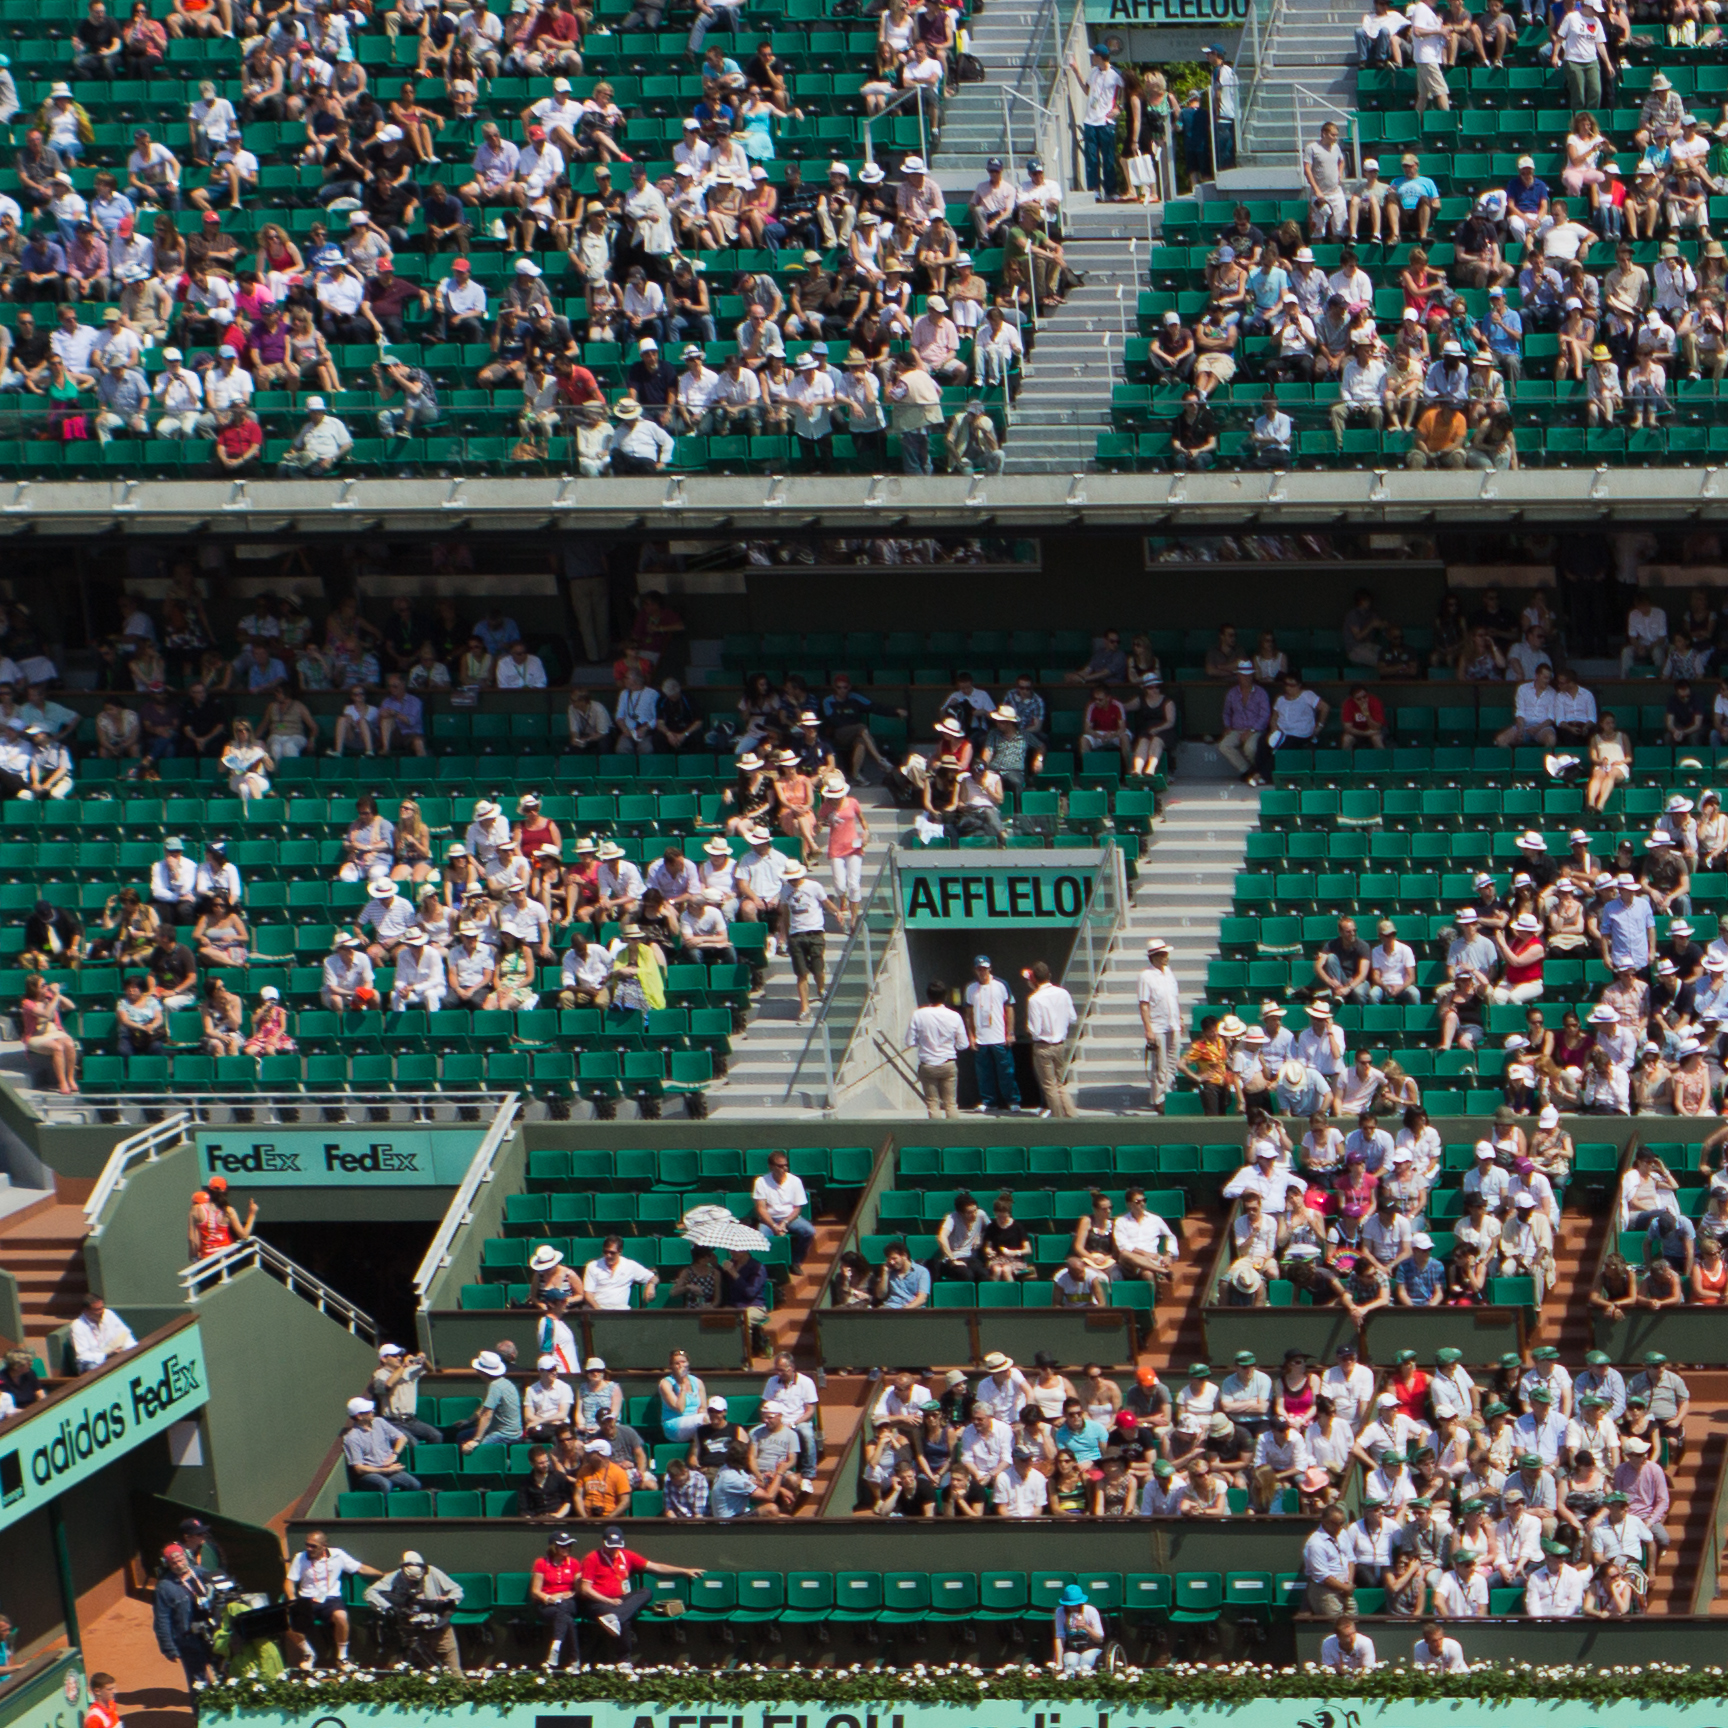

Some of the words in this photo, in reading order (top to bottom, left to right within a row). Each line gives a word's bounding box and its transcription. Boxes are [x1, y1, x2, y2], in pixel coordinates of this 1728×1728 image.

[206, 1144, 302, 1173] FedEx
[324, 1144, 418, 1173] FedEx
[32, 1397, 126, 1486] adidas
[129, 1353, 202, 1425] FedEx
